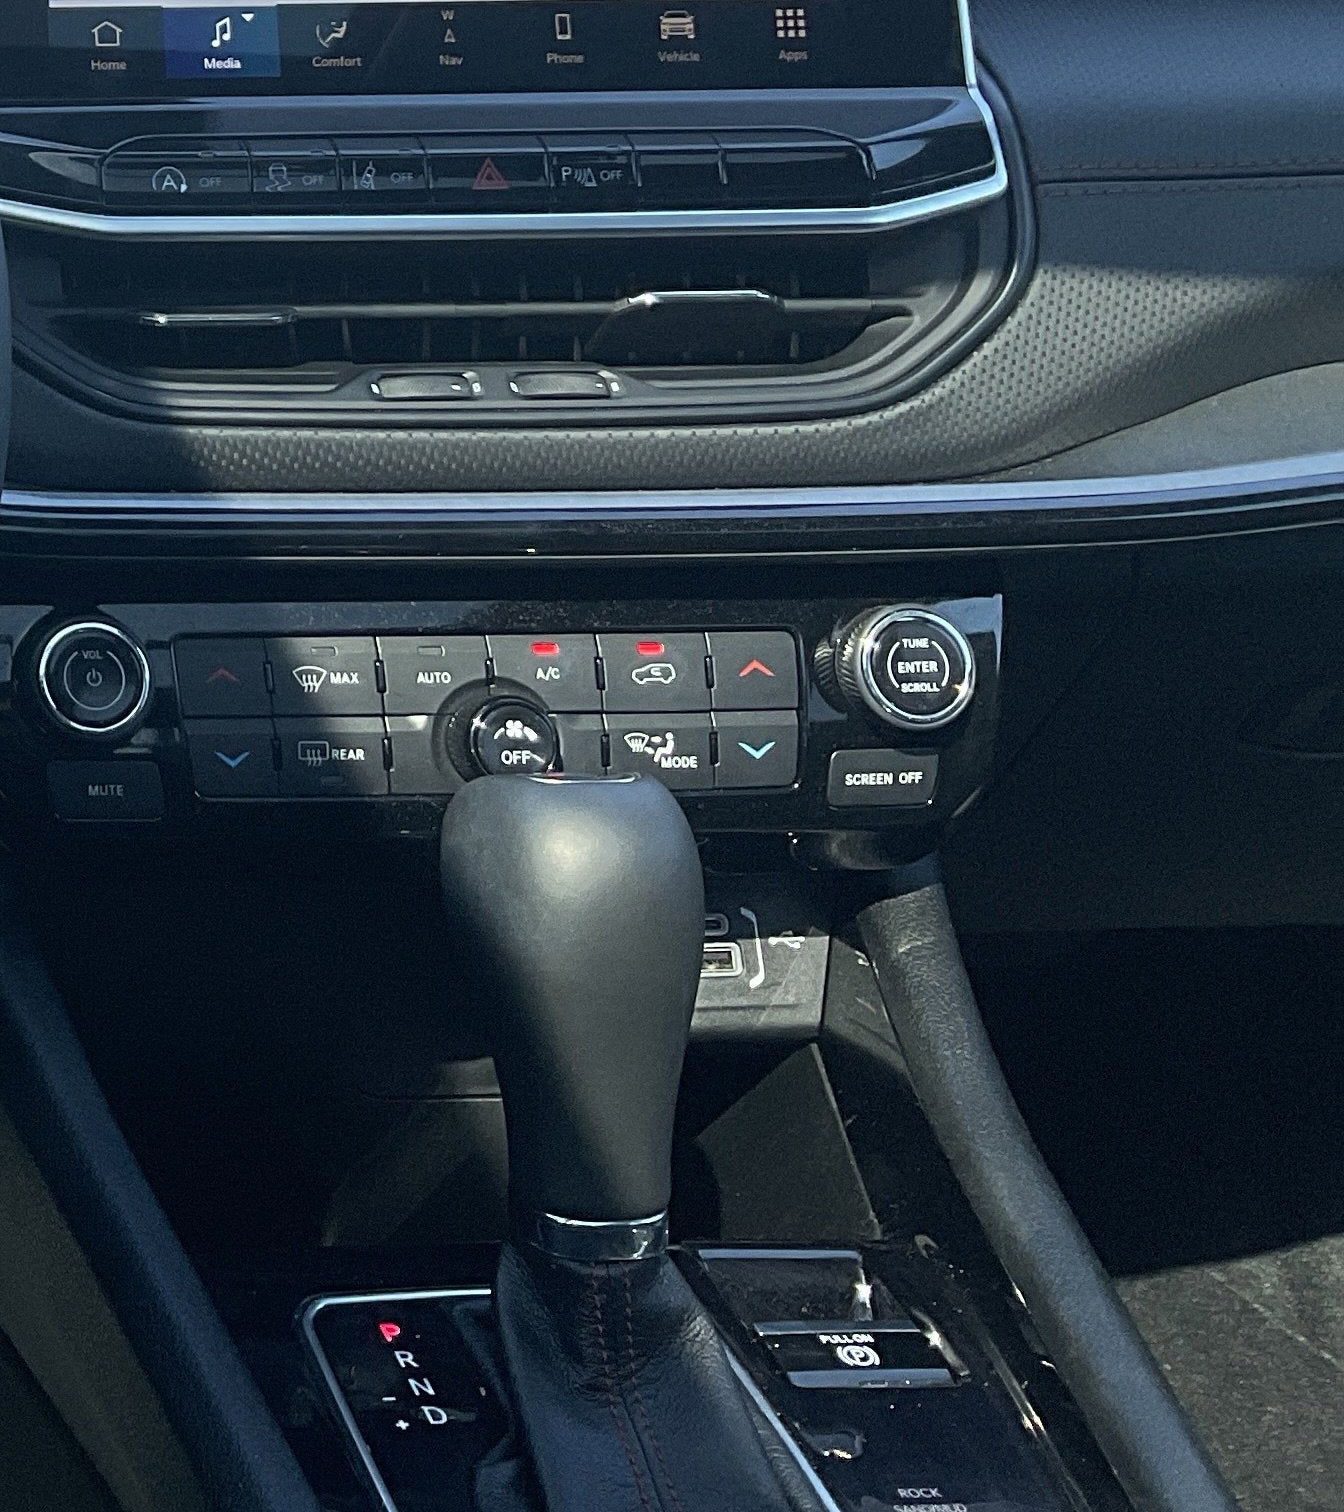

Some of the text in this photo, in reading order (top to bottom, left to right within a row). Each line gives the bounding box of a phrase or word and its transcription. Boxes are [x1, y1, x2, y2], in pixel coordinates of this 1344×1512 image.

[312, 55, 362, 68] Comfort
[440, 54, 463, 66] Nav
[546, 52, 584, 64] Phone
[657, 50, 700, 63] Vehicle
[778, 49, 808, 63] Apps
[91, 59, 127, 71] Home
[204, 57, 241, 70] Media
[302, 175, 324, 185] OFF
[390, 172, 413, 183] OFF
[599, 170, 624, 181] OFF
[902, 637, 929, 649] TUNE
[82, 649, 103, 661] VOL
[535, 666, 560, 681] A/C
[897, 660, 938, 675] ENTER
[329, 672, 359, 685] MAX
[416, 671, 451, 685] AUTO
[900, 681, 940, 694] SCROLL
[331, 748, 365, 762] REAR
[500, 750, 531, 765] OFF
[660, 755, 698, 770] MODE
[845, 771, 923, 786] SCREEN OFF
[88, 784, 124, 798] MUTE
[378, 1322, 401, 1342] P
[819, 1333, 874, 1344] PULL ON
[394, 1350, 418, 1369] R
[408, 1377, 435, 1397] N
[421, 1405, 447, 1426] D
[897, 1488, 942, 1498] ROCK
